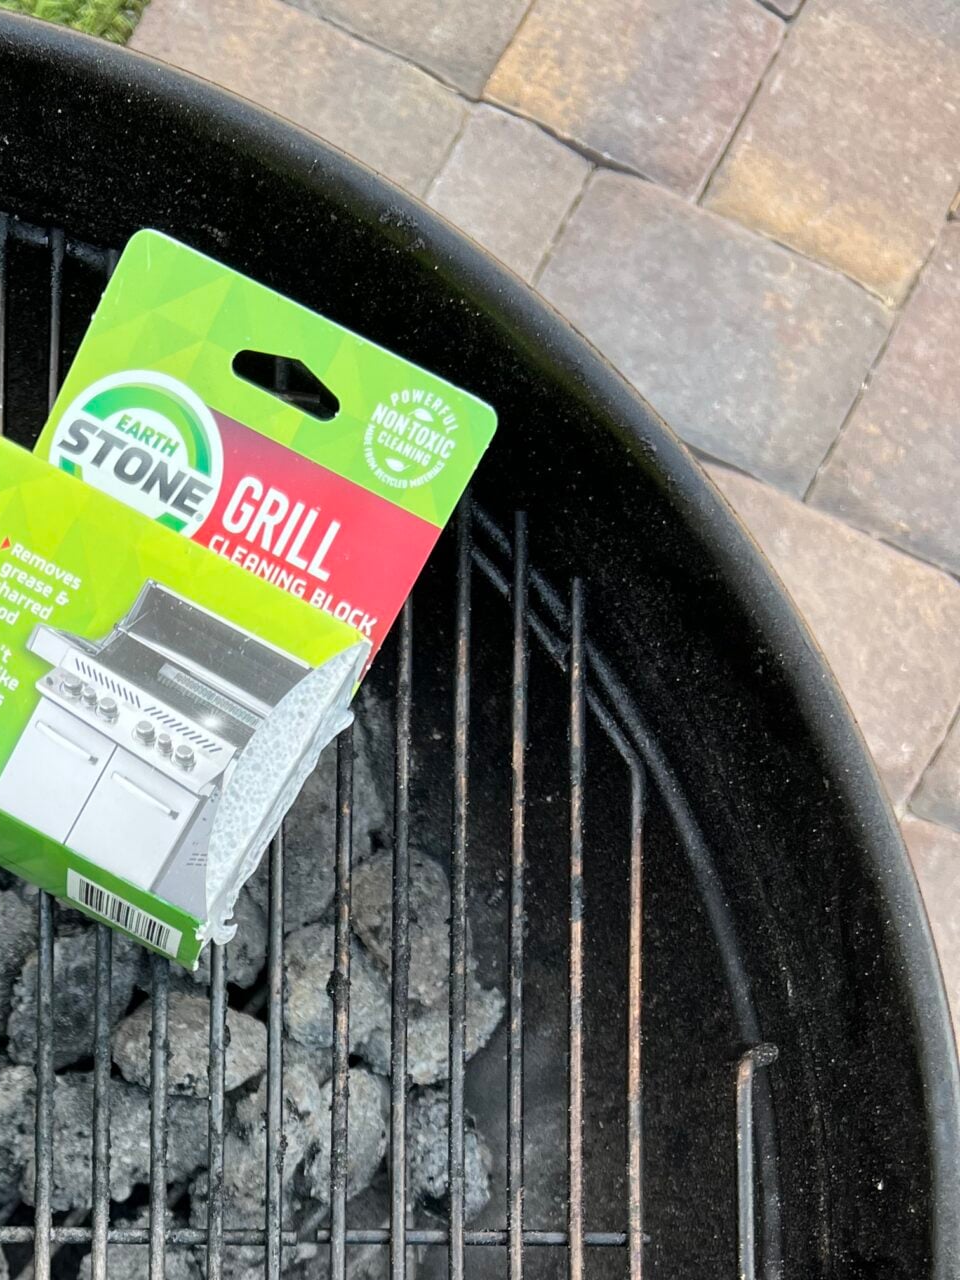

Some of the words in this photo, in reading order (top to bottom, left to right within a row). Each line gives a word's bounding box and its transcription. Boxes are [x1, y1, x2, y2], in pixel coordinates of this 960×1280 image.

[390, 388, 459, 434] POWERFUL
[115, 414, 180, 458] EARTH
[377, 430, 431, 467] CLEANING
[57, 418, 214, 519] STONE
[222, 474, 341, 582] GRILL
[10, 543, 82, 590] Removes
[208, 534, 307, 599] CLEANING
[309, 587, 378, 637] BLOCK
[55, 591, 70, 606] &
